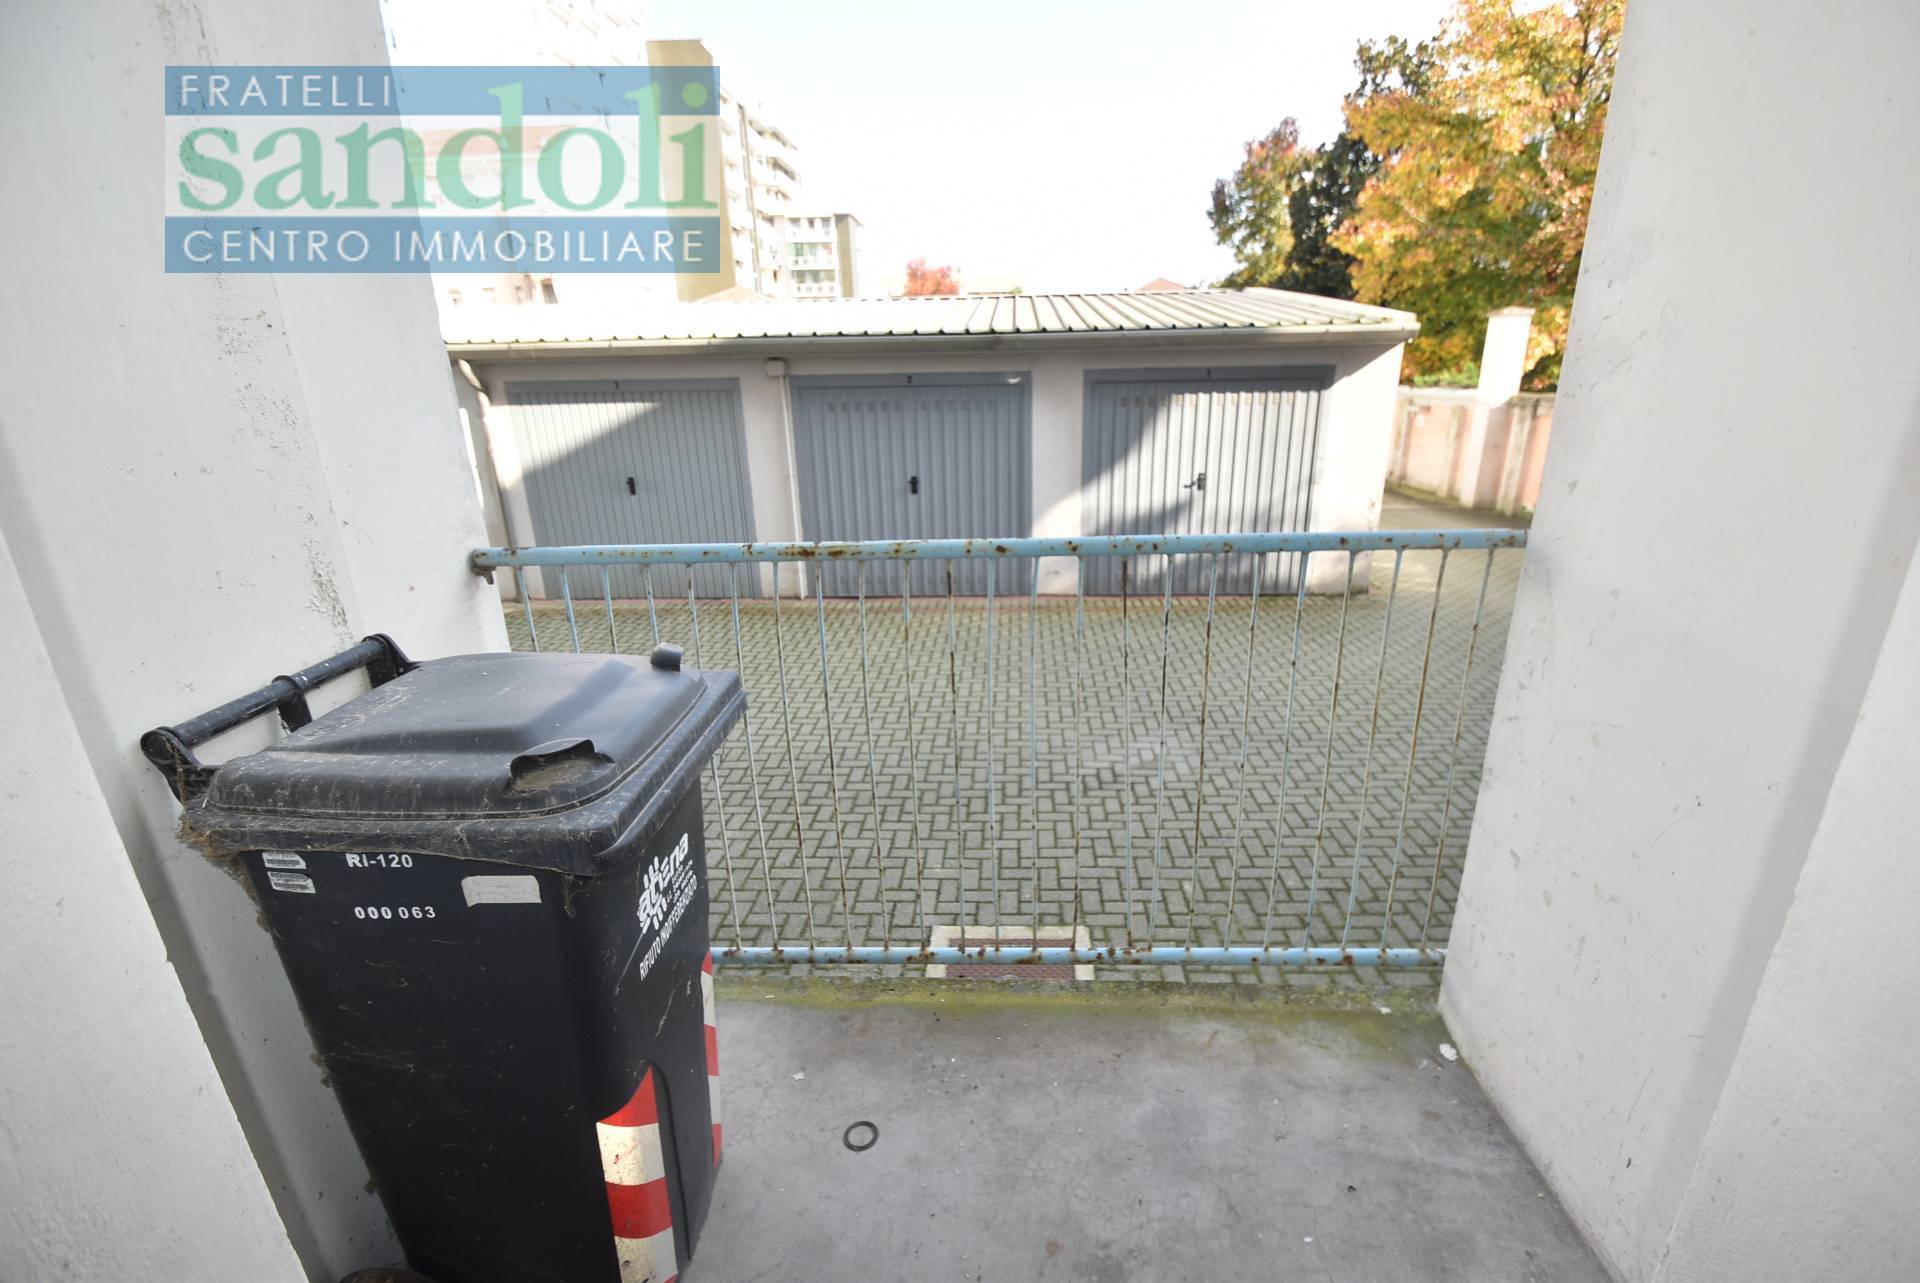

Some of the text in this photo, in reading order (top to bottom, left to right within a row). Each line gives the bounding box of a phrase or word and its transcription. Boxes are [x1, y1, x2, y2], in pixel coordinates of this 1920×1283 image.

[345, 852, 413, 868] RI-120
[354, 906, 436, 920] 000 063
[639, 936, 661, 981] RIFIUTO
